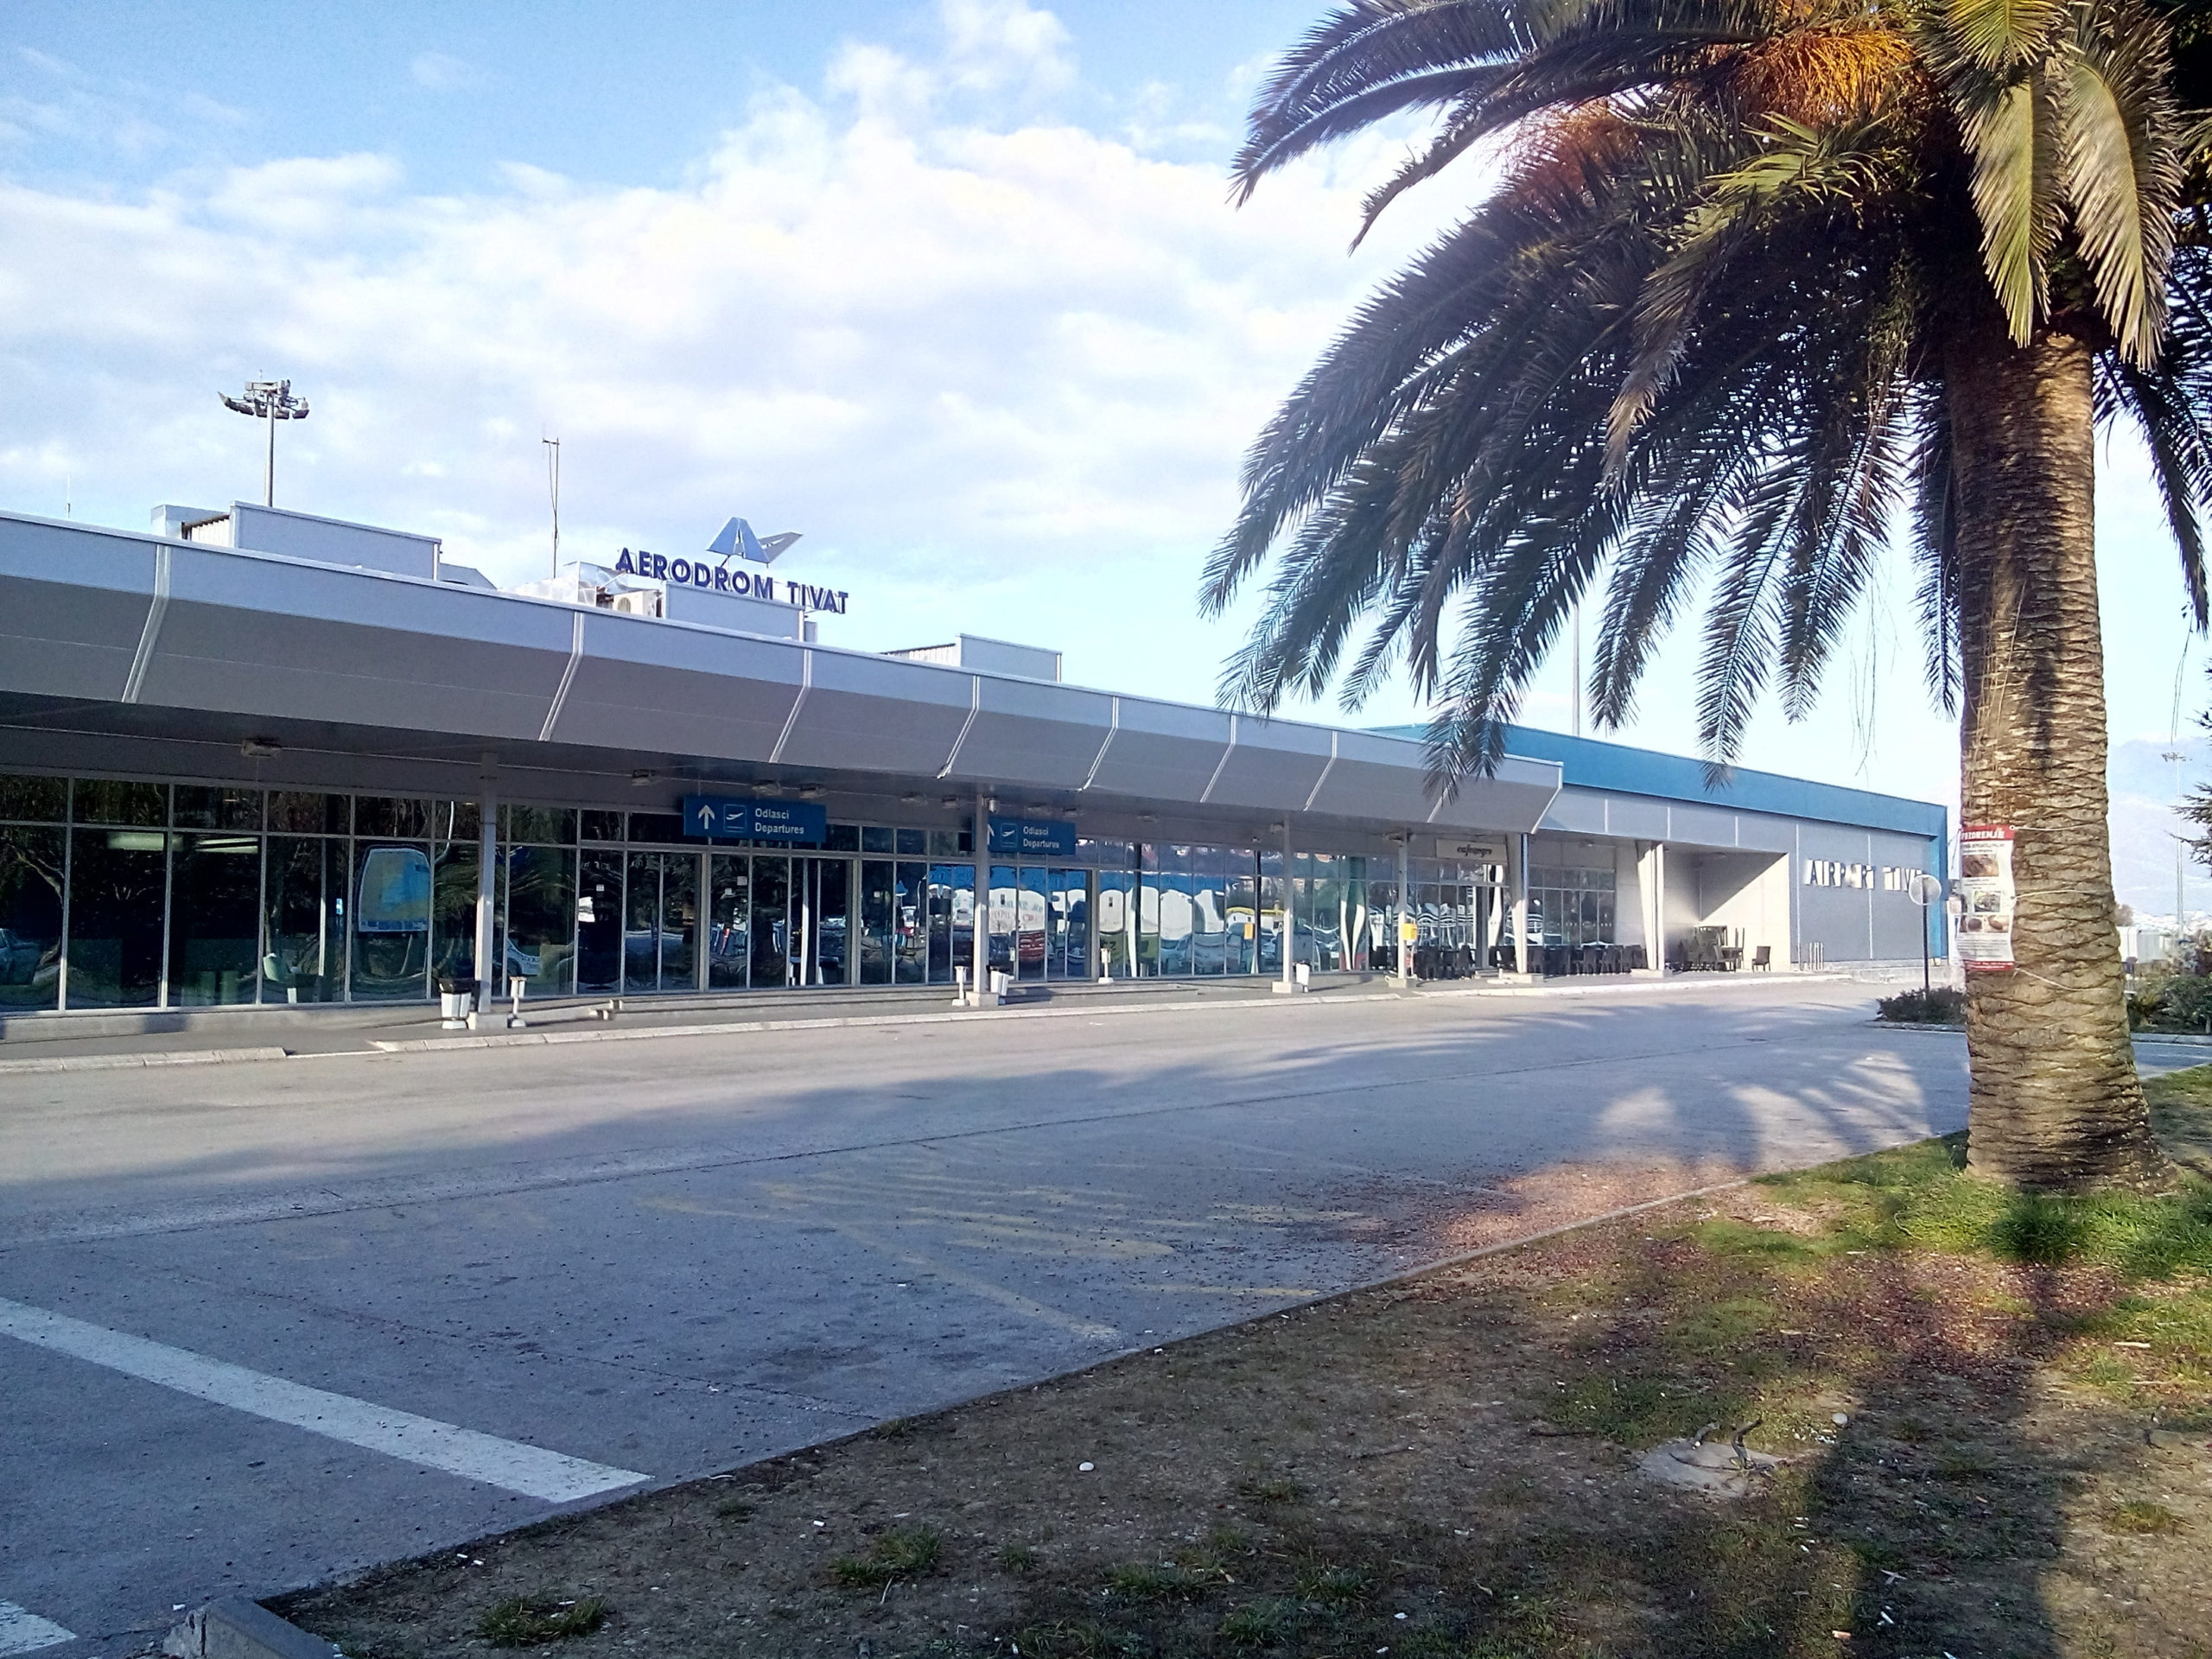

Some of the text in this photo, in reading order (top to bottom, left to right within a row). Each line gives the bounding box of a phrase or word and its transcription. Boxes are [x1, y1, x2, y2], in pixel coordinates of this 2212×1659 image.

[615, 547, 849, 614] AERODROM TIVAT
[754, 807, 790, 820] Odlasci
[754, 822, 804, 835] Departures
[1023, 838, 1059, 849] Departures
